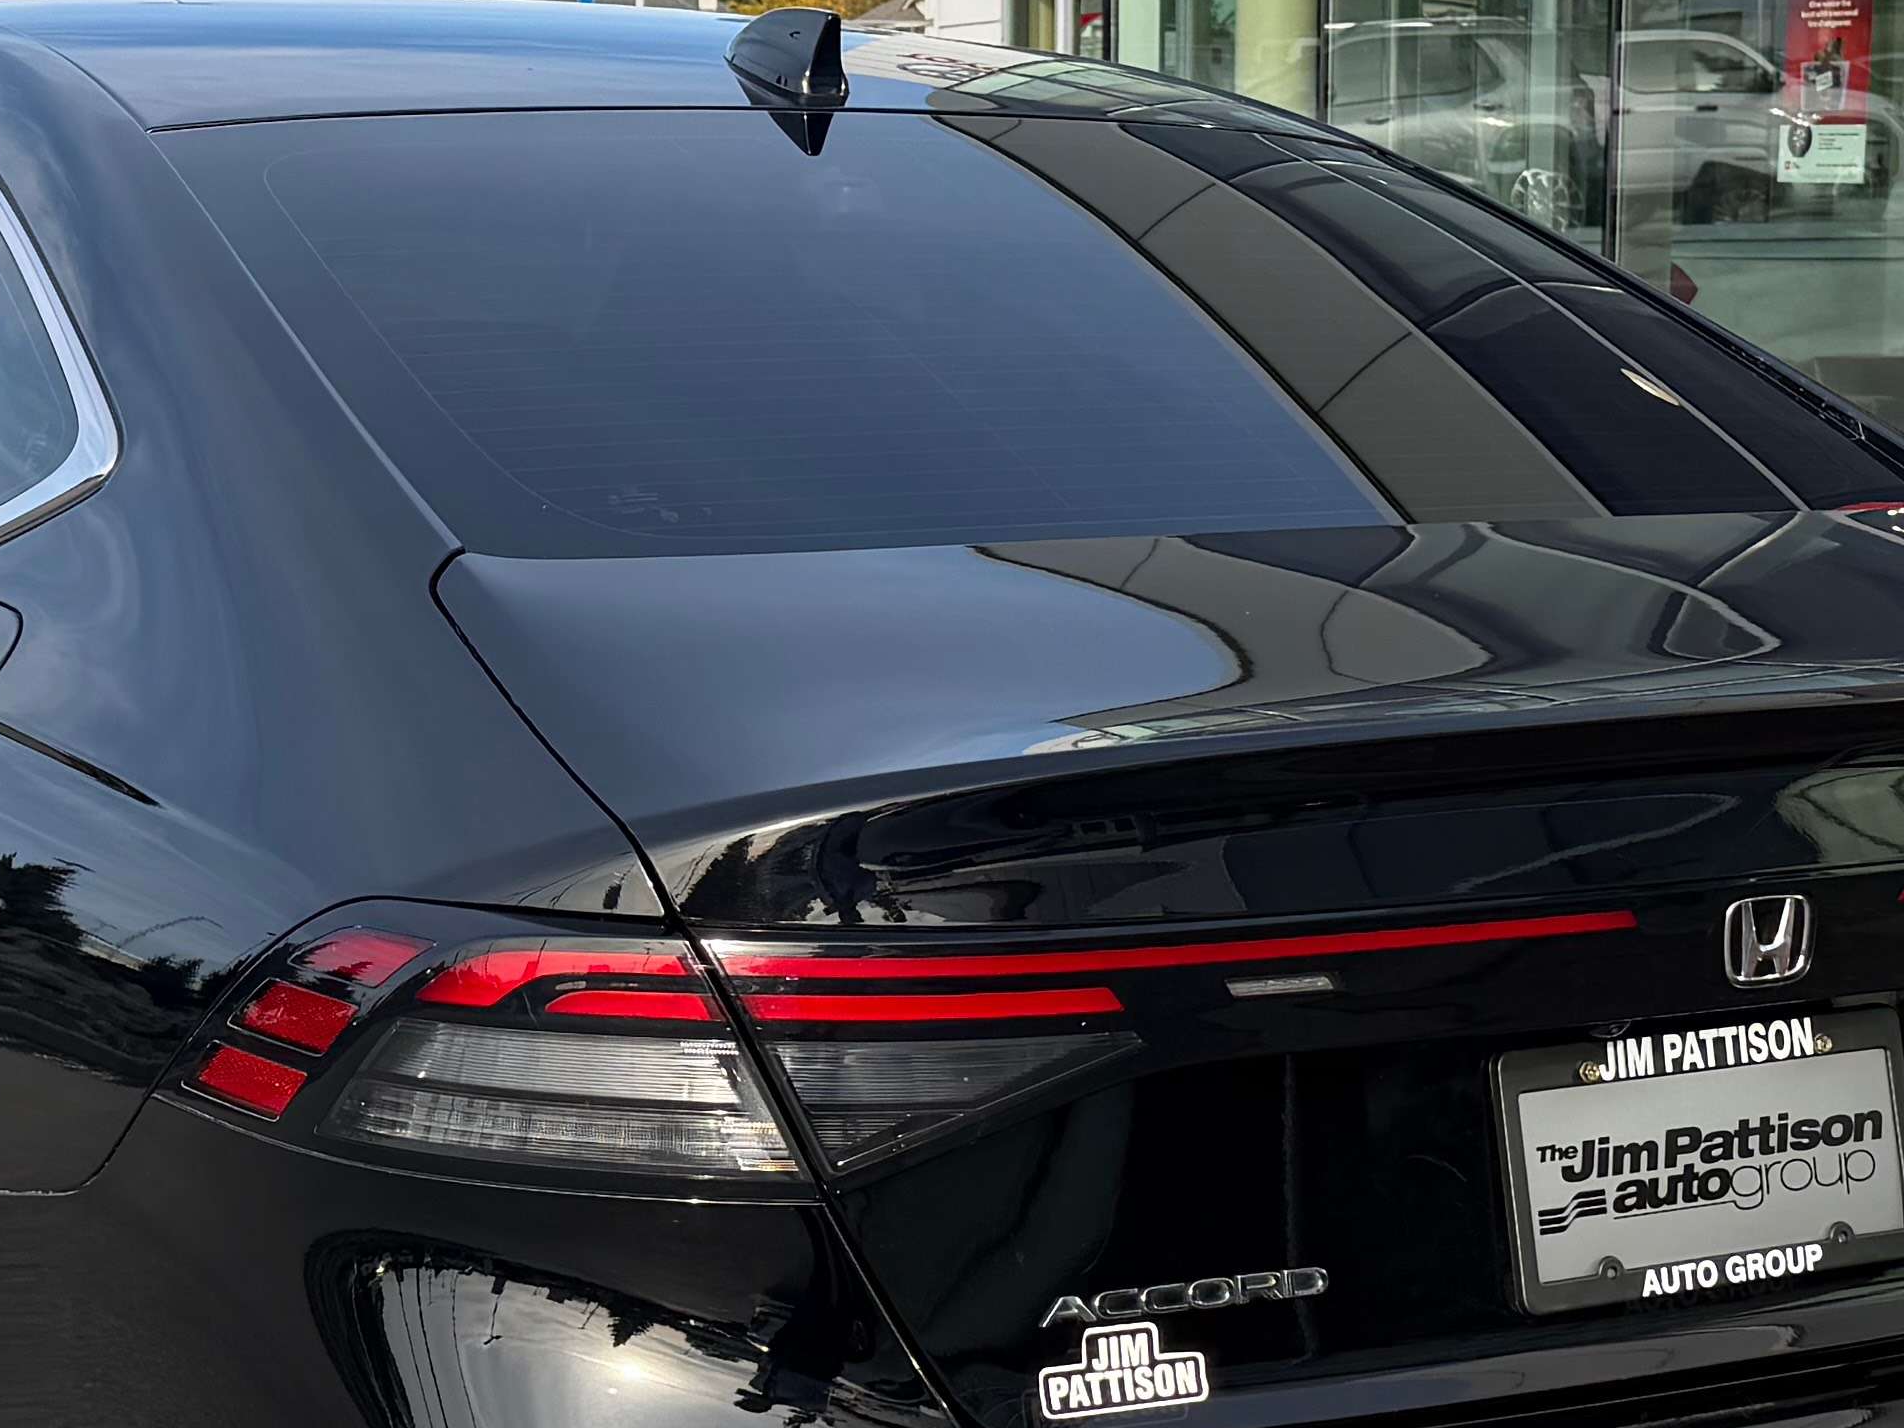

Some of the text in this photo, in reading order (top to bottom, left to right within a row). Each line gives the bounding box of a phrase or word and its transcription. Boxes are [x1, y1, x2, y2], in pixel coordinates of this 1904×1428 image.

[1598, 1016, 1815, 1082] JIM PATTISON
[1536, 1108, 1883, 1183] The Jim Pattison
[1038, 1266, 1330, 1328] ACCORD
[1642, 1243, 1823, 1297] AUTO GROUP
[1091, 1333, 1150, 1373] JIM
[1047, 1360, 1198, 1411] PATTISON
